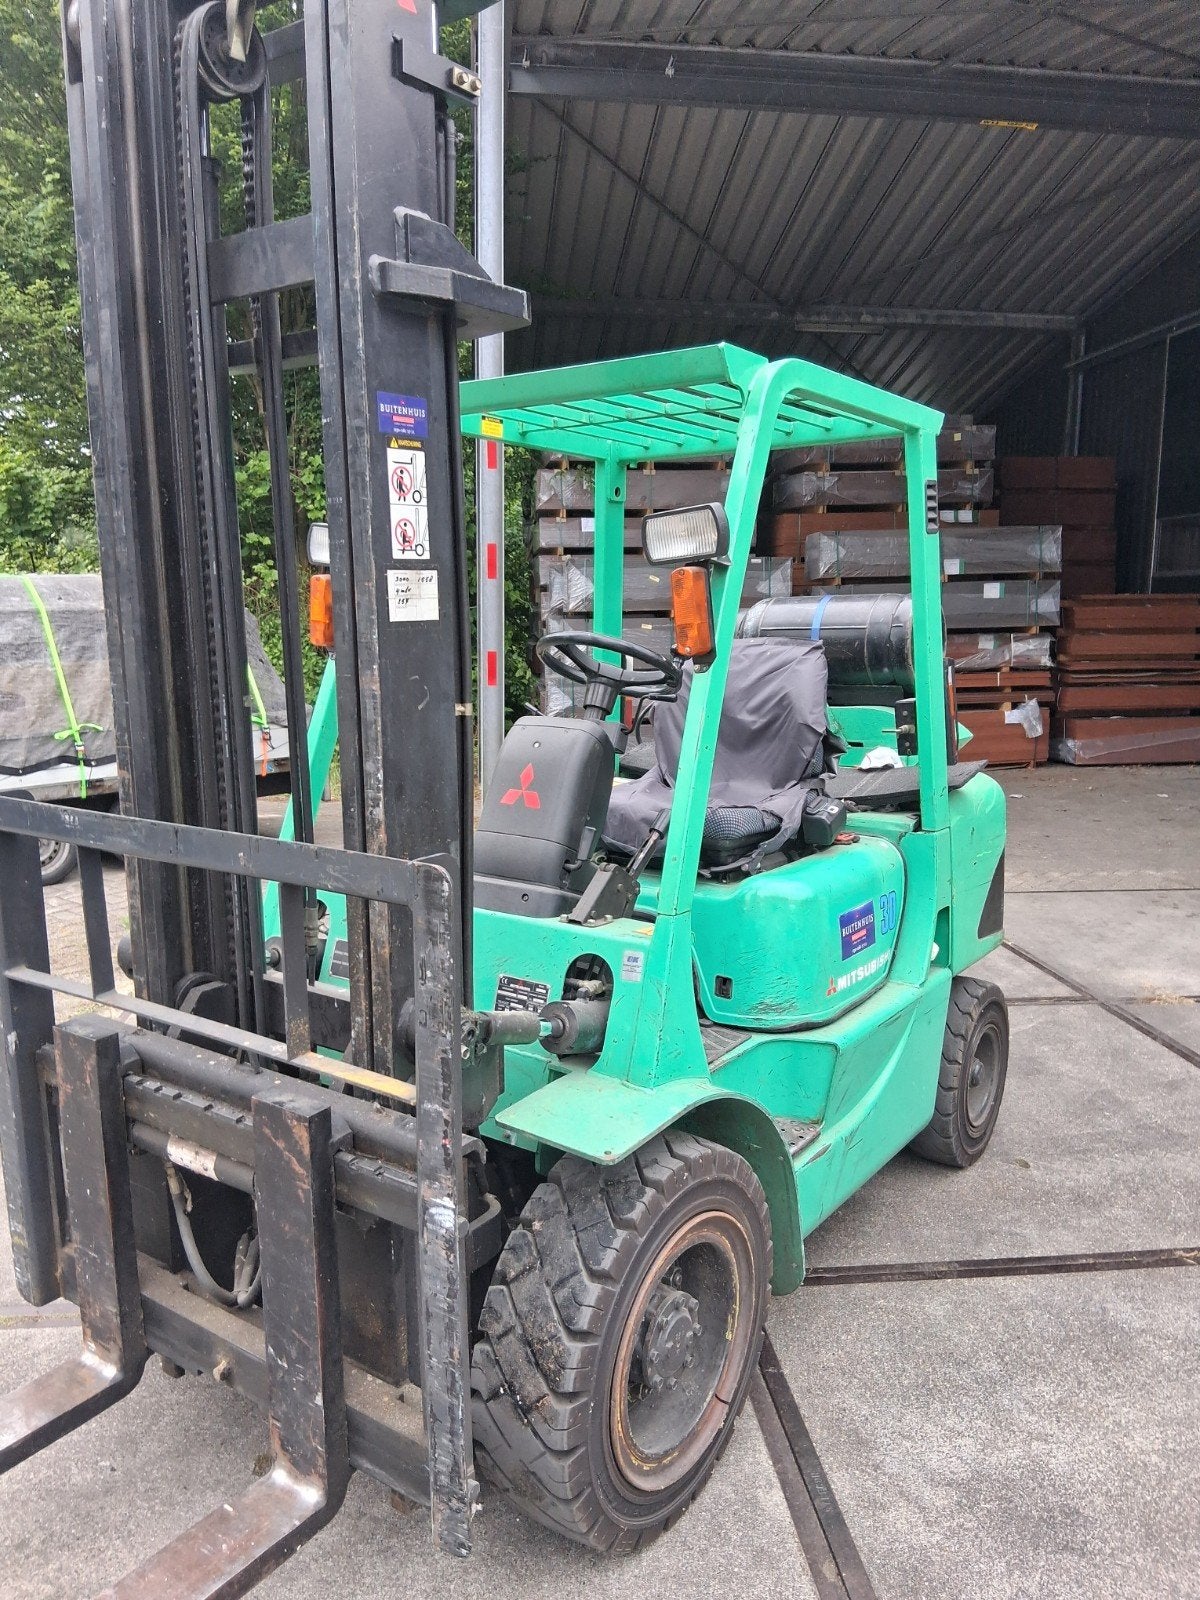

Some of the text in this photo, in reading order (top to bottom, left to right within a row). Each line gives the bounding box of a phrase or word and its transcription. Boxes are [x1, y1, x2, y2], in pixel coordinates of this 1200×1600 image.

[380, 403, 425, 418] BUITENHUIS
[880, 890, 896, 935] 30
[842, 913, 874, 937] BUITENHUIS
